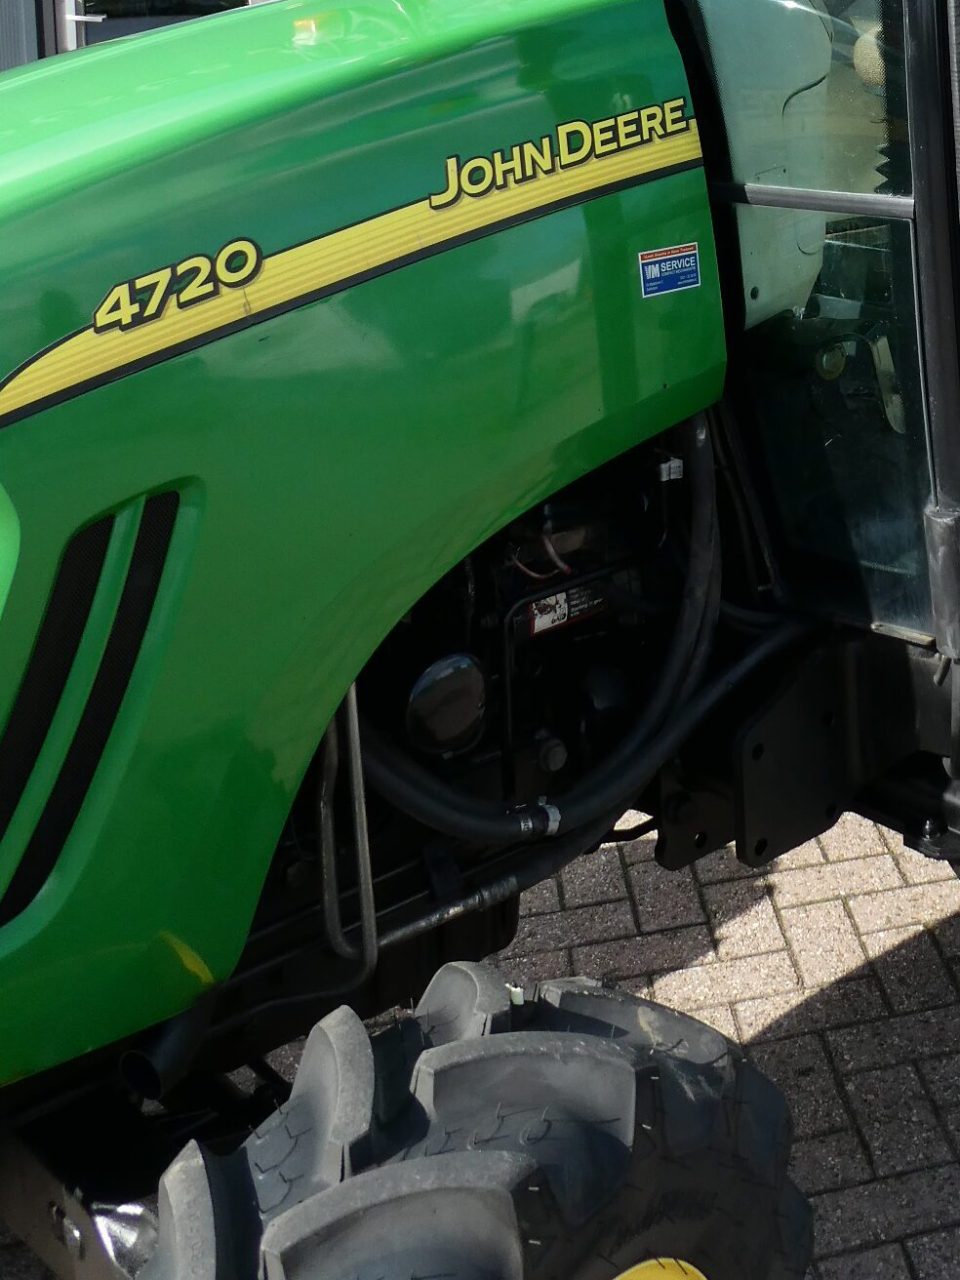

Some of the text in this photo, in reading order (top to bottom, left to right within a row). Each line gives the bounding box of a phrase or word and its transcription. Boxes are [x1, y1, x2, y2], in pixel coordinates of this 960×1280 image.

[430, 98, 688, 209] JOHN DEERE
[95, 238, 261, 331] 4720
[660, 256, 696, 272] SERVICE
